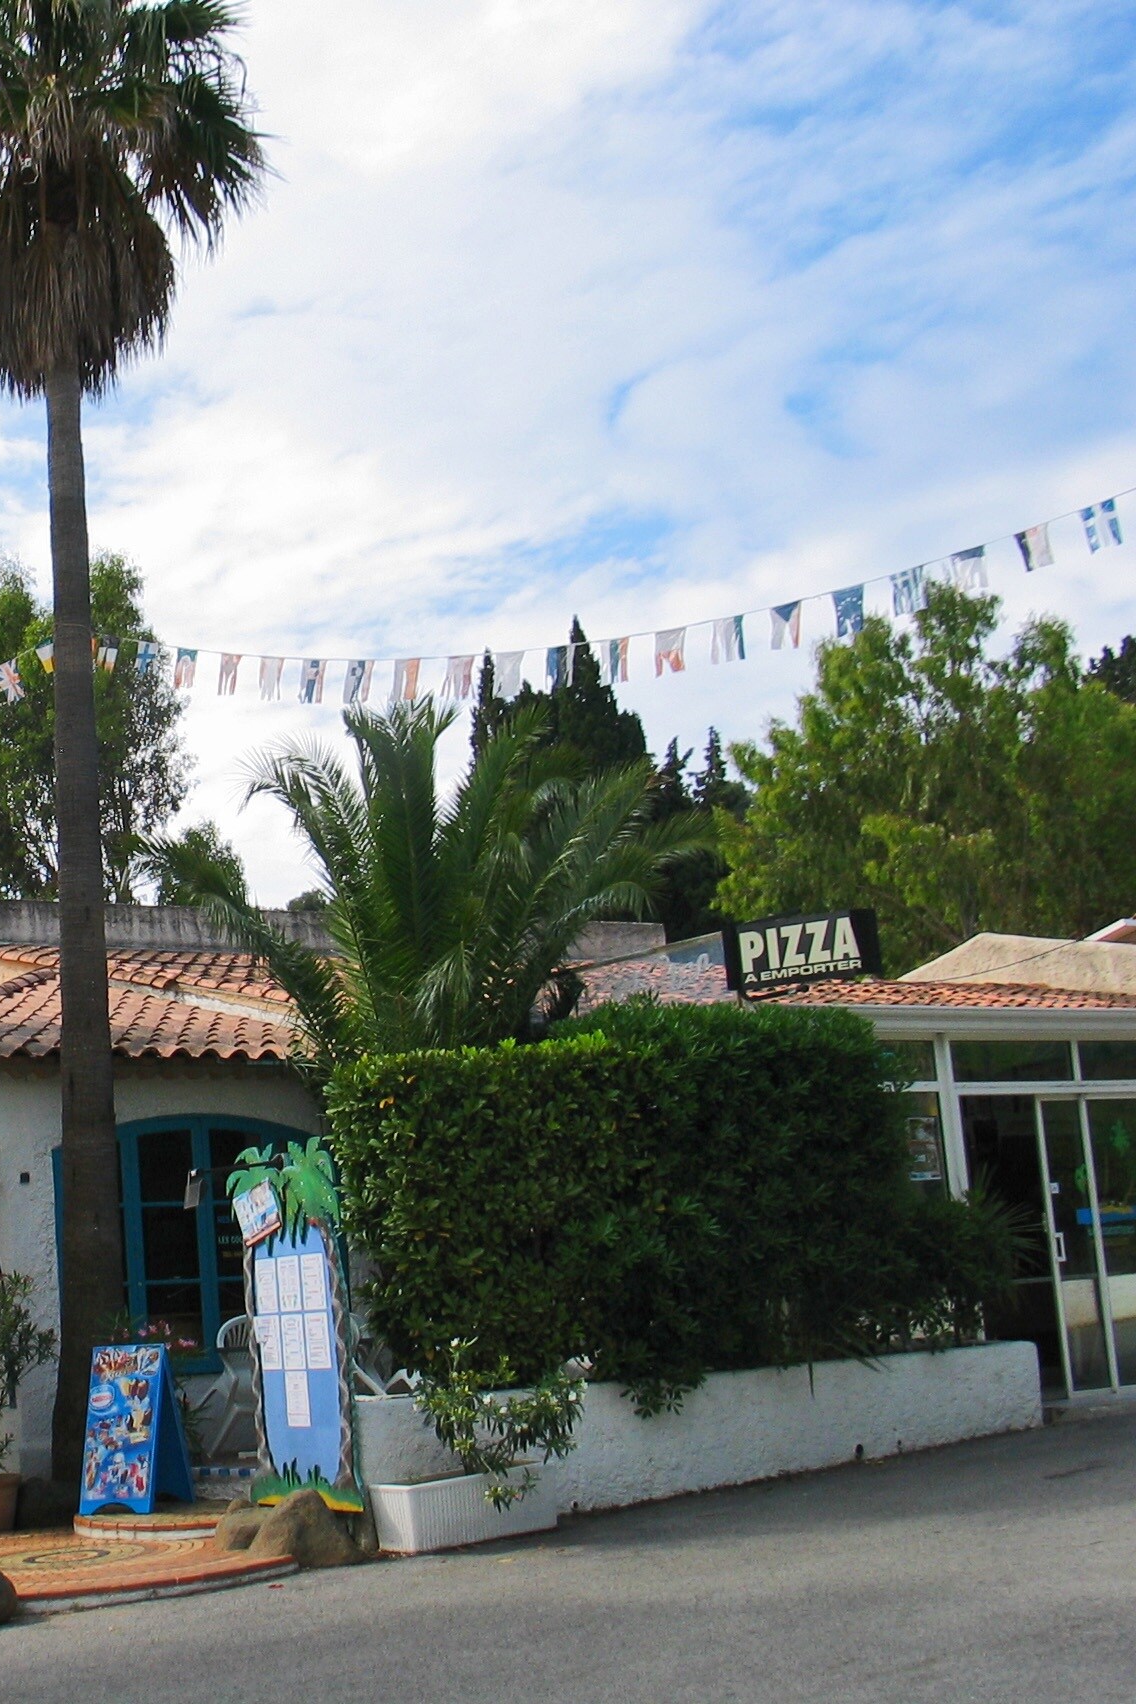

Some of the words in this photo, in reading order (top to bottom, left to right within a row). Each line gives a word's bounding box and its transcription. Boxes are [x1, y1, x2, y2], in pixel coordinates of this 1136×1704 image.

[739, 917, 861, 974] PIZZA
[745, 974, 757, 984] A
[761, 960, 862, 982] EMPORTER
